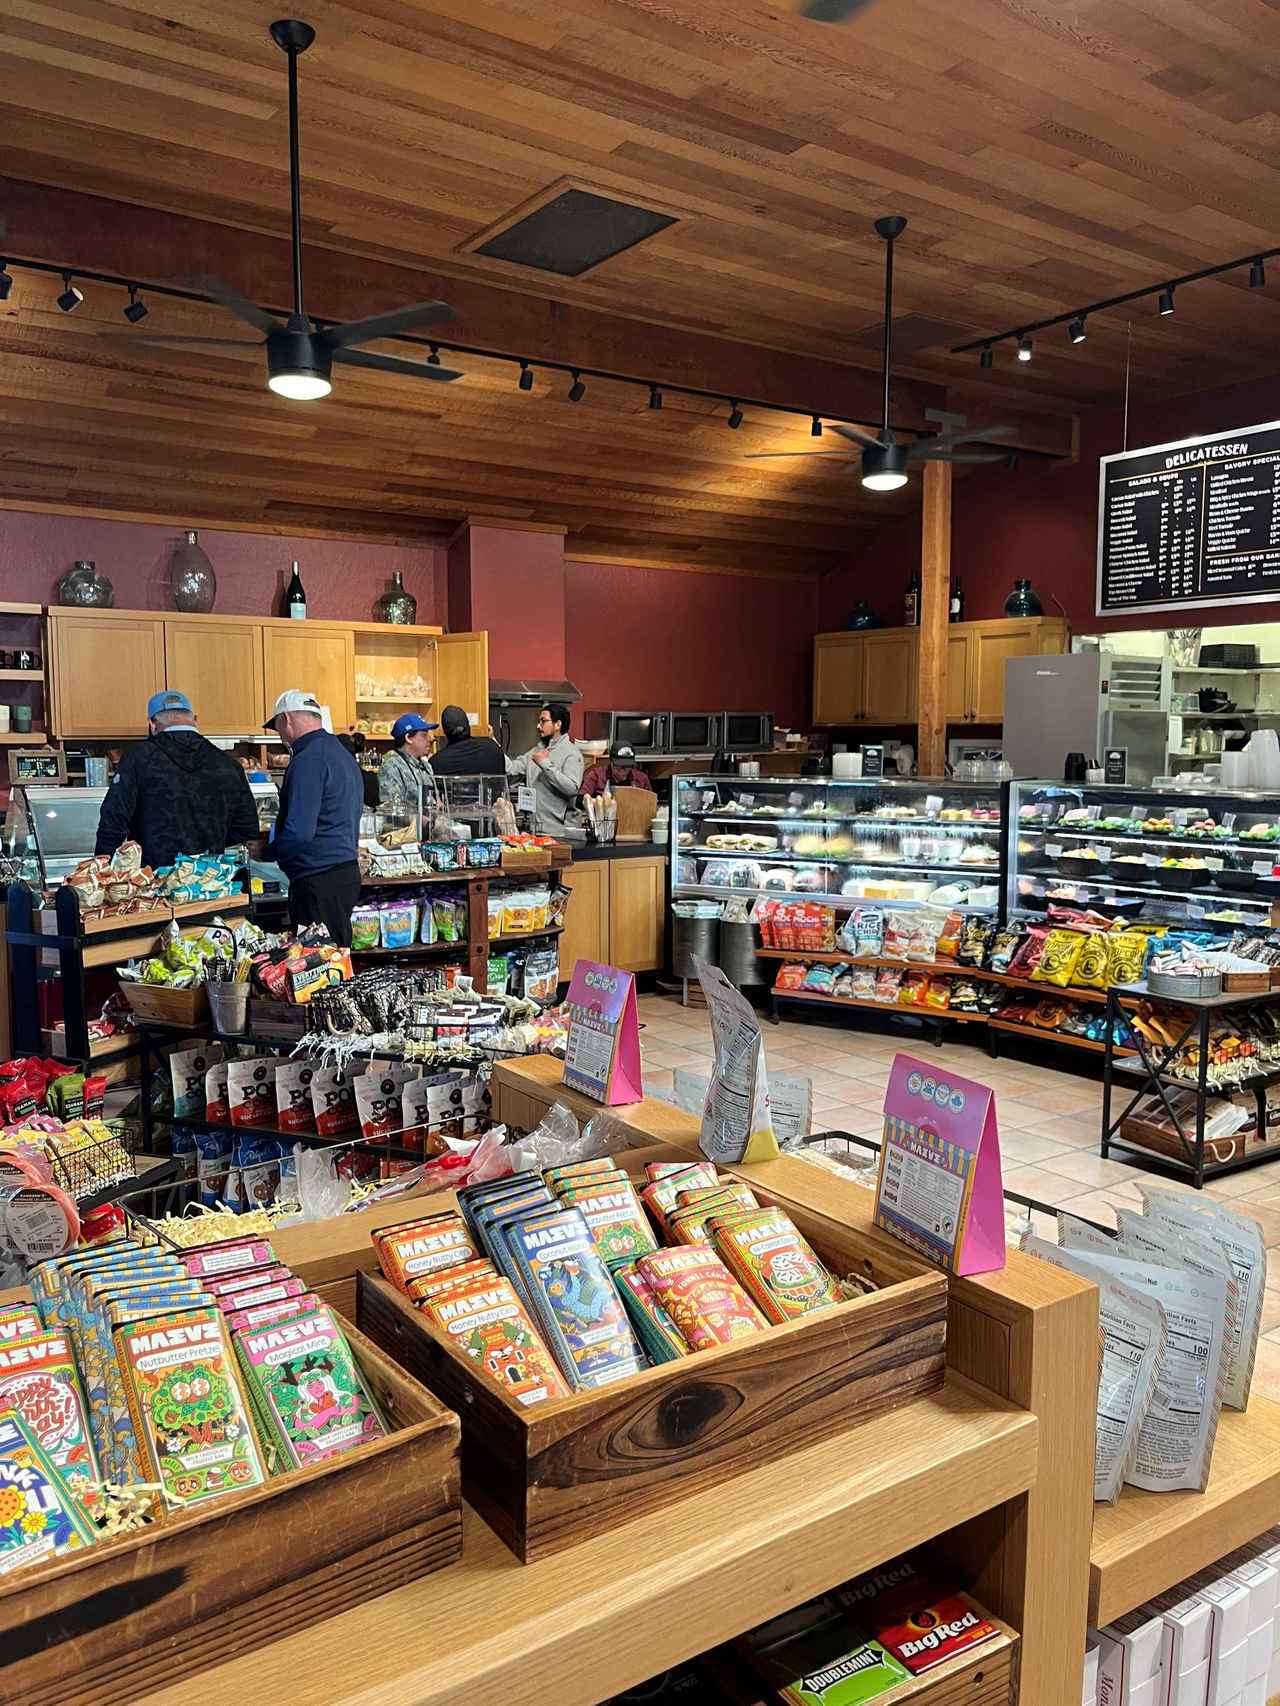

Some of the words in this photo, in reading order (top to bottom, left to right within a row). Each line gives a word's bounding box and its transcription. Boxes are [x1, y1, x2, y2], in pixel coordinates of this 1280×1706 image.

[1165, 443, 1248, 469] DELICATESSEN
[1209, 558, 1230, 566] FRESH
[1231, 556, 1249, 564] FROM
[1250, 554, 1265, 562] OUR
[397, 1230, 468, 1257] MAEVE
[523, 1221, 590, 1249] MAEVE
[408, 1258, 431, 1270] Honey
[1237, 1270, 1249, 1280] 110
[439, 1287, 514, 1321] MAEVE
[451, 1315, 479, 1332] Honey
[130, 1321, 220, 1355] MAEVE
[248, 1316, 332, 1355] MAEVE
[139, 1350, 189, 1369] Nutbutter
[1128, 1350, 1142, 1362] 110
[1193, 1344, 1208, 1356] 100
[804, 1649, 880, 1692] DOUBLEMINT
